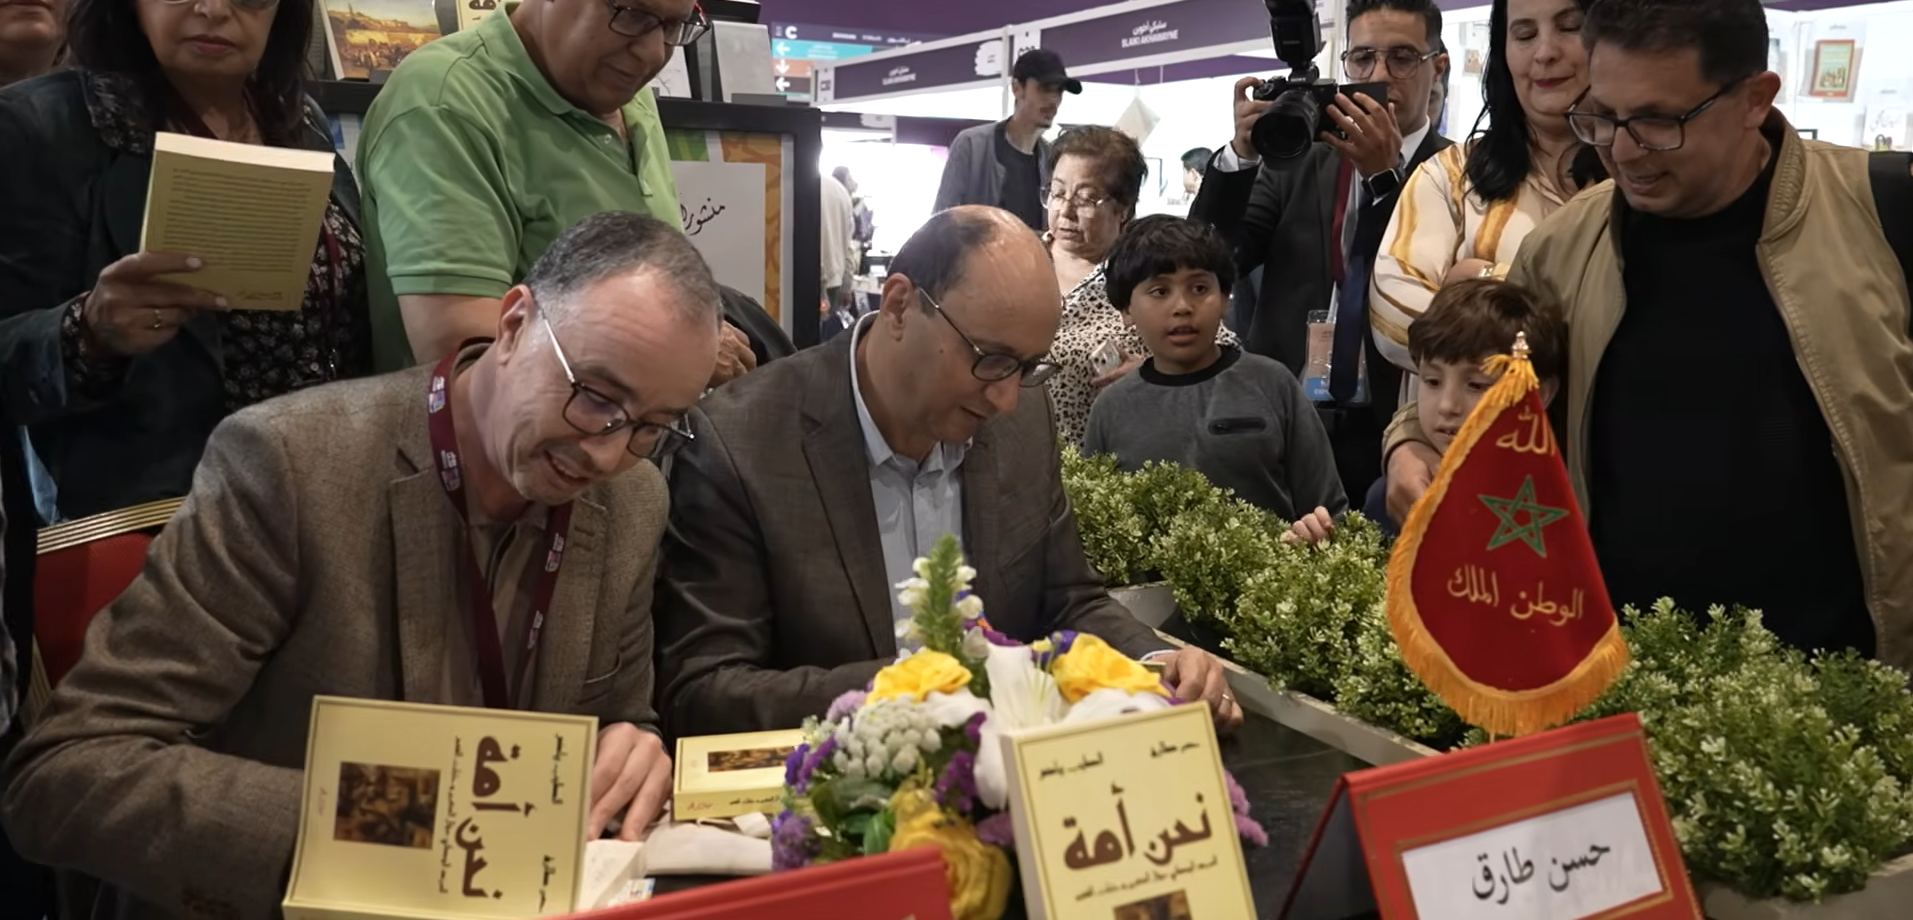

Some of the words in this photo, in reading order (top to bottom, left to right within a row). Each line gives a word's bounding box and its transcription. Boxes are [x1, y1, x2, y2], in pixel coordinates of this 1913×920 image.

[785, 26, 797, 39] C
[1496, 404, 1556, 457] الله
[1446, 563, 1499, 607] الملك
[1510, 581, 1584, 627] الوطن
[471, 735, 537, 818] أمة
[1062, 781, 1135, 871] أمة
[1144, 792, 1212, 866] نحن
[455, 816, 503, 900] نحن
[1472, 846, 1535, 905] طارق
[1549, 844, 1611, 892] حسن
